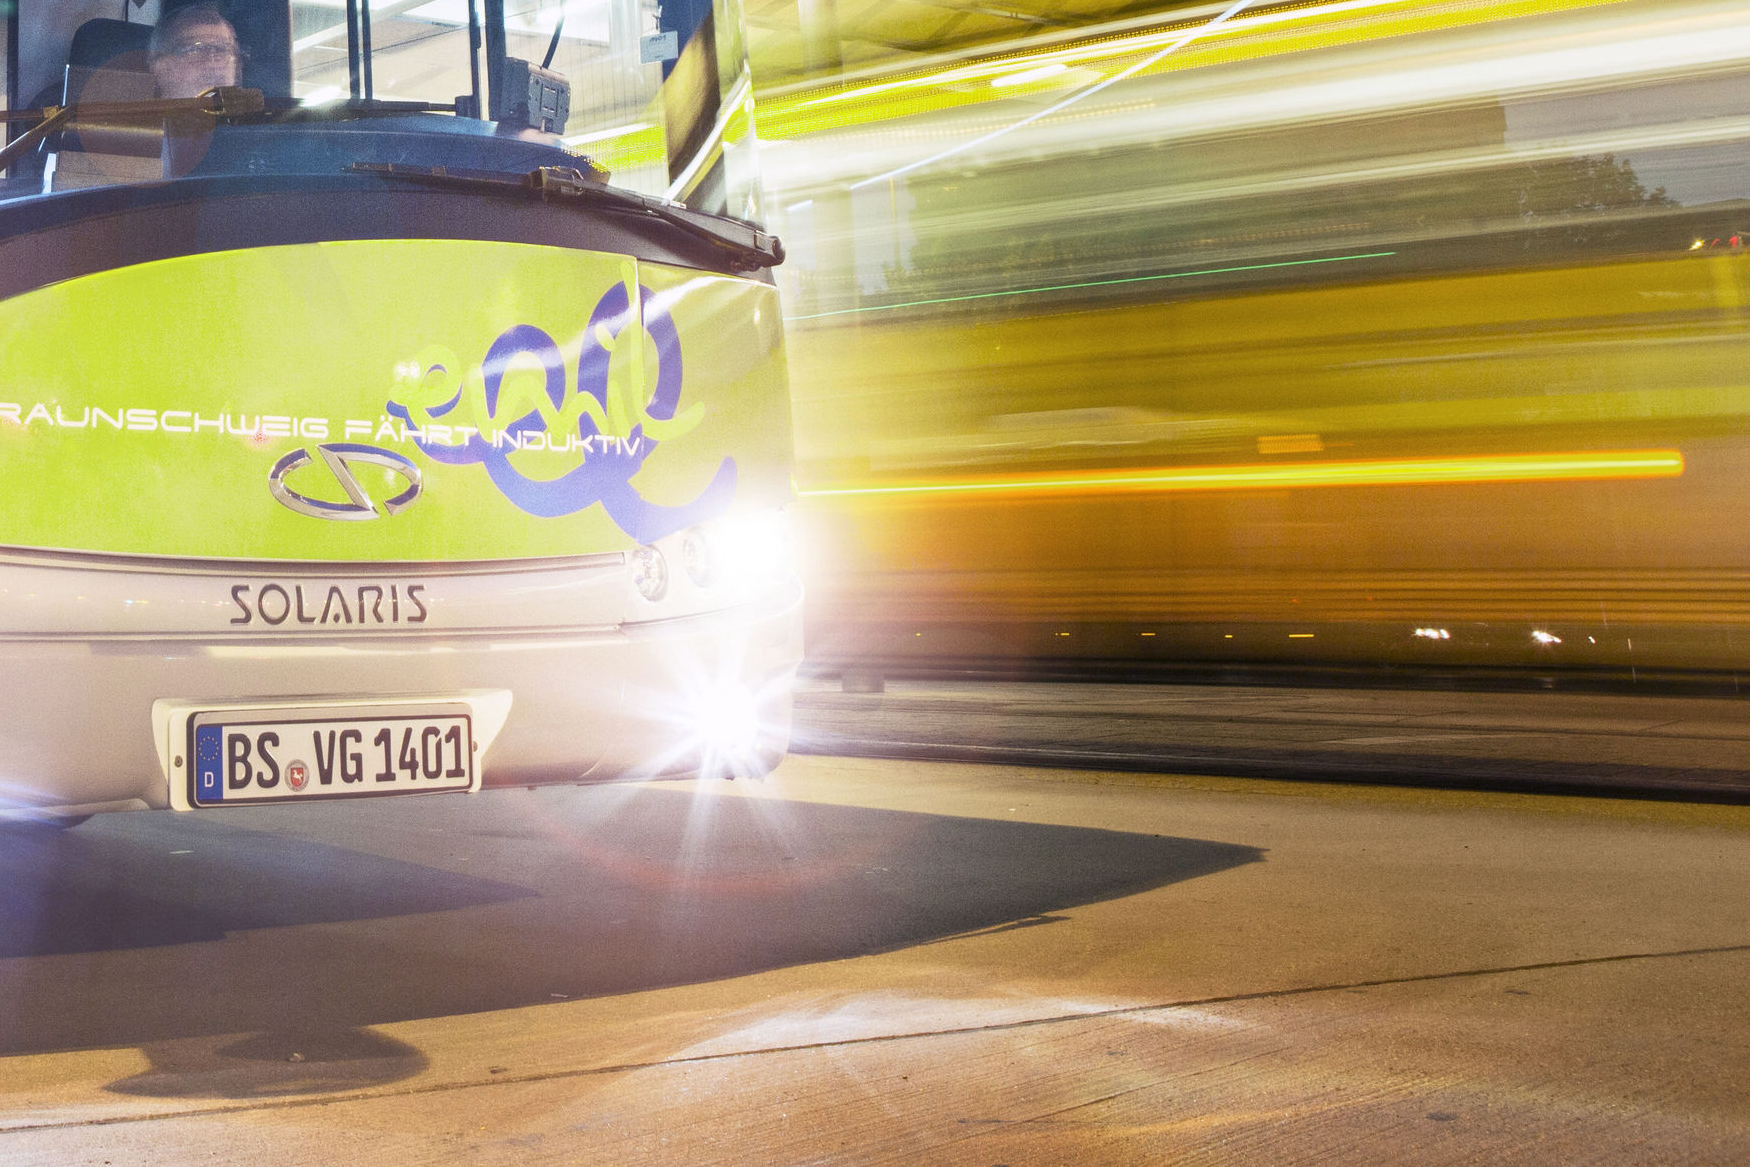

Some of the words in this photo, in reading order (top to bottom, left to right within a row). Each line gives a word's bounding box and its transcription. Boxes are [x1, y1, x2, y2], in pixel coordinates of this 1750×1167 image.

[344, 414, 478, 447] FÄHRT
[492, 428, 641, 456] INDUKTIV
[229, 584, 428, 626] SOLARIS
[227, 731, 281, 790] BS
[313, 728, 364, 785] VG
[374, 724, 466, 783] 1401
[204, 771, 214, 788] D
